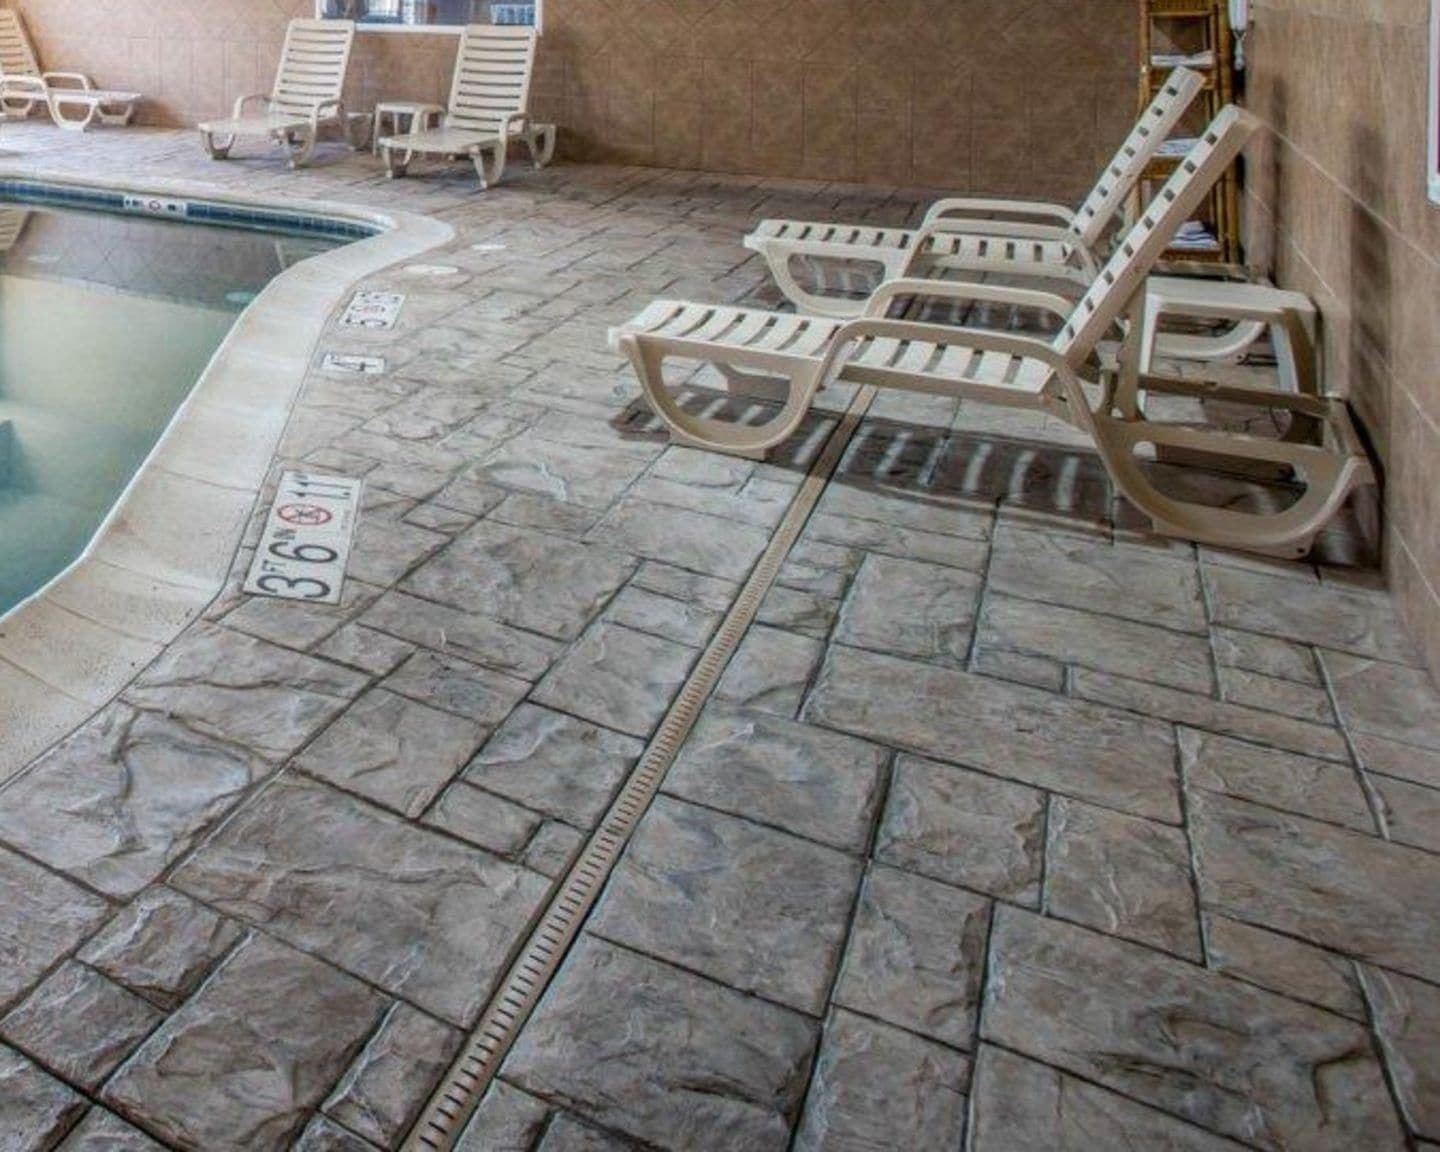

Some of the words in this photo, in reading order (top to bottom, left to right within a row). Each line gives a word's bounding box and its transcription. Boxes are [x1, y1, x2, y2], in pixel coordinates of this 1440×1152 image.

[268, 541, 338, 564] 6
[261, 559, 289, 575] FT
[256, 574, 332, 598] 3
